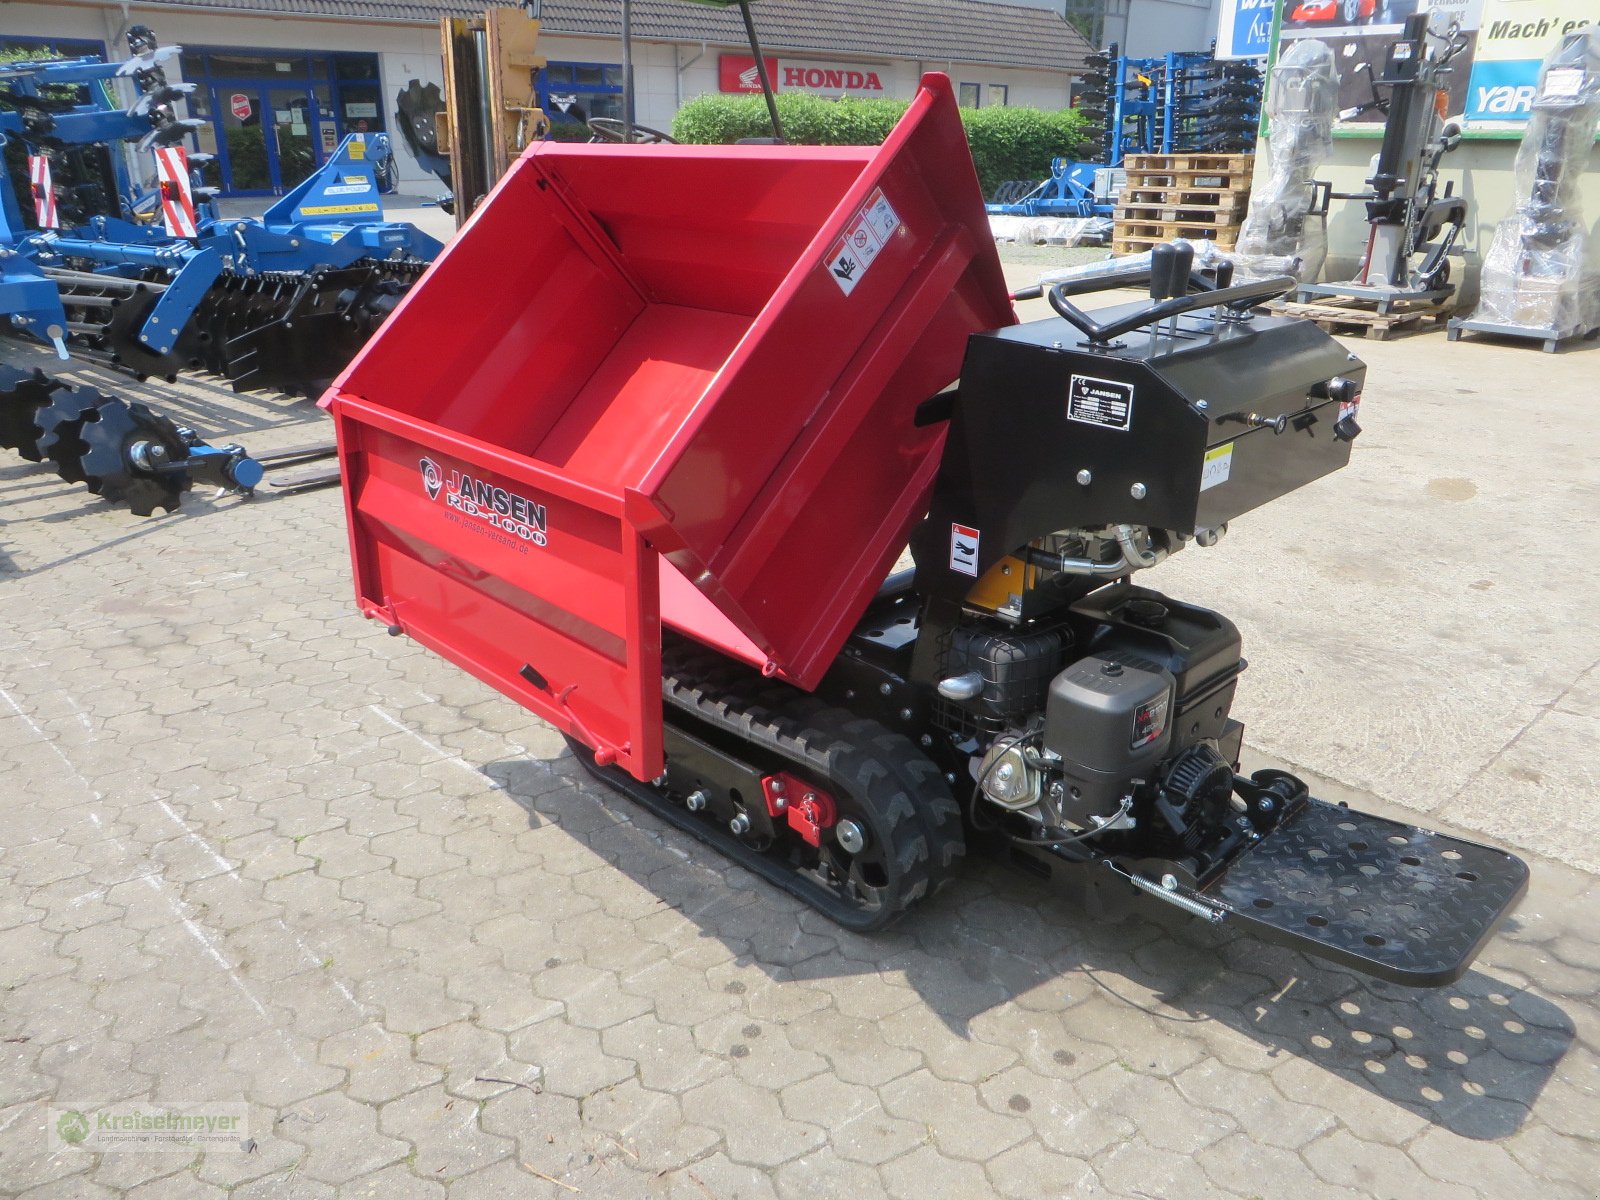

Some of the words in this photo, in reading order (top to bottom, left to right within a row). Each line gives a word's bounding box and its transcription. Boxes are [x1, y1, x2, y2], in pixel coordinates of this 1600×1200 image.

[784, 67, 883, 90] HONDA
[1090, 389, 1122, 400] JANSEN
[446, 469, 547, 534] JANSEN
[446, 492, 547, 547] RD-1000
[444, 510, 529, 555] www.jansen-versand.de
